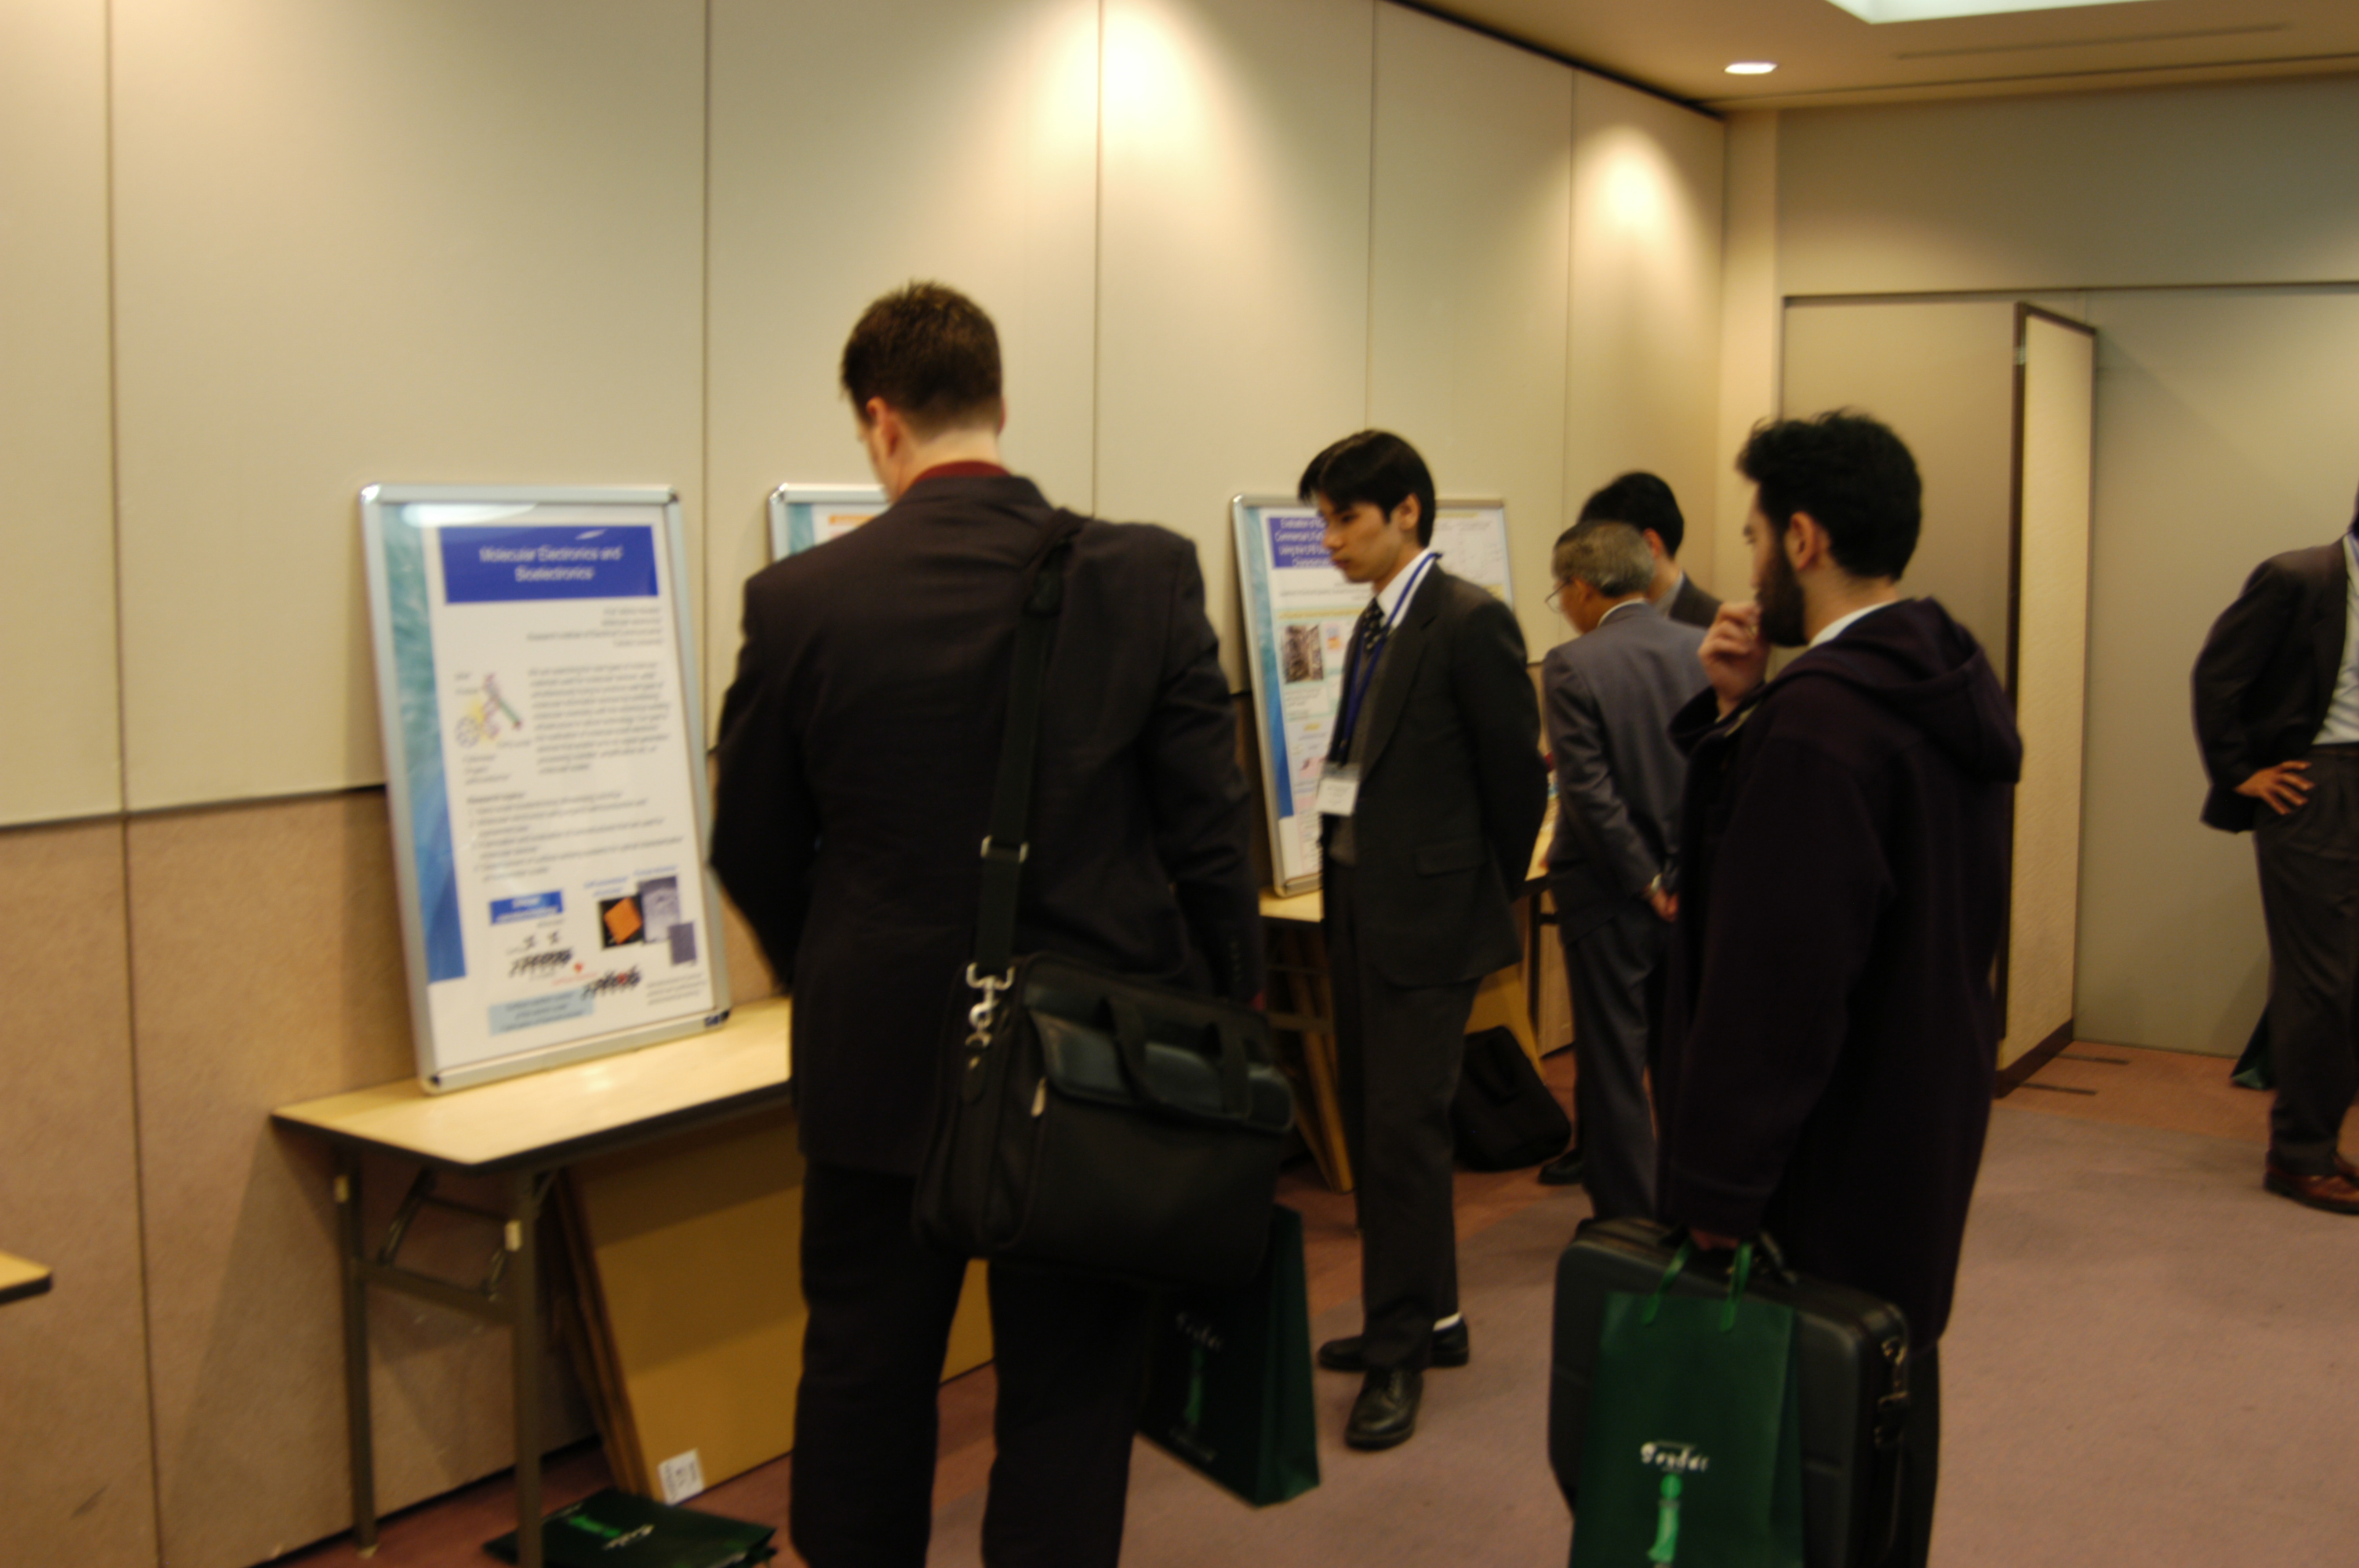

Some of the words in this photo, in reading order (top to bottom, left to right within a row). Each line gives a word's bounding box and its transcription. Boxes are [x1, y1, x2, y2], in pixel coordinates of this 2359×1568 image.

[479, 546, 536, 562] Molecular
[537, 544, 598, 561] Electronics
[599, 544, 623, 561] and
[514, 564, 595, 583] Bioelectronics
